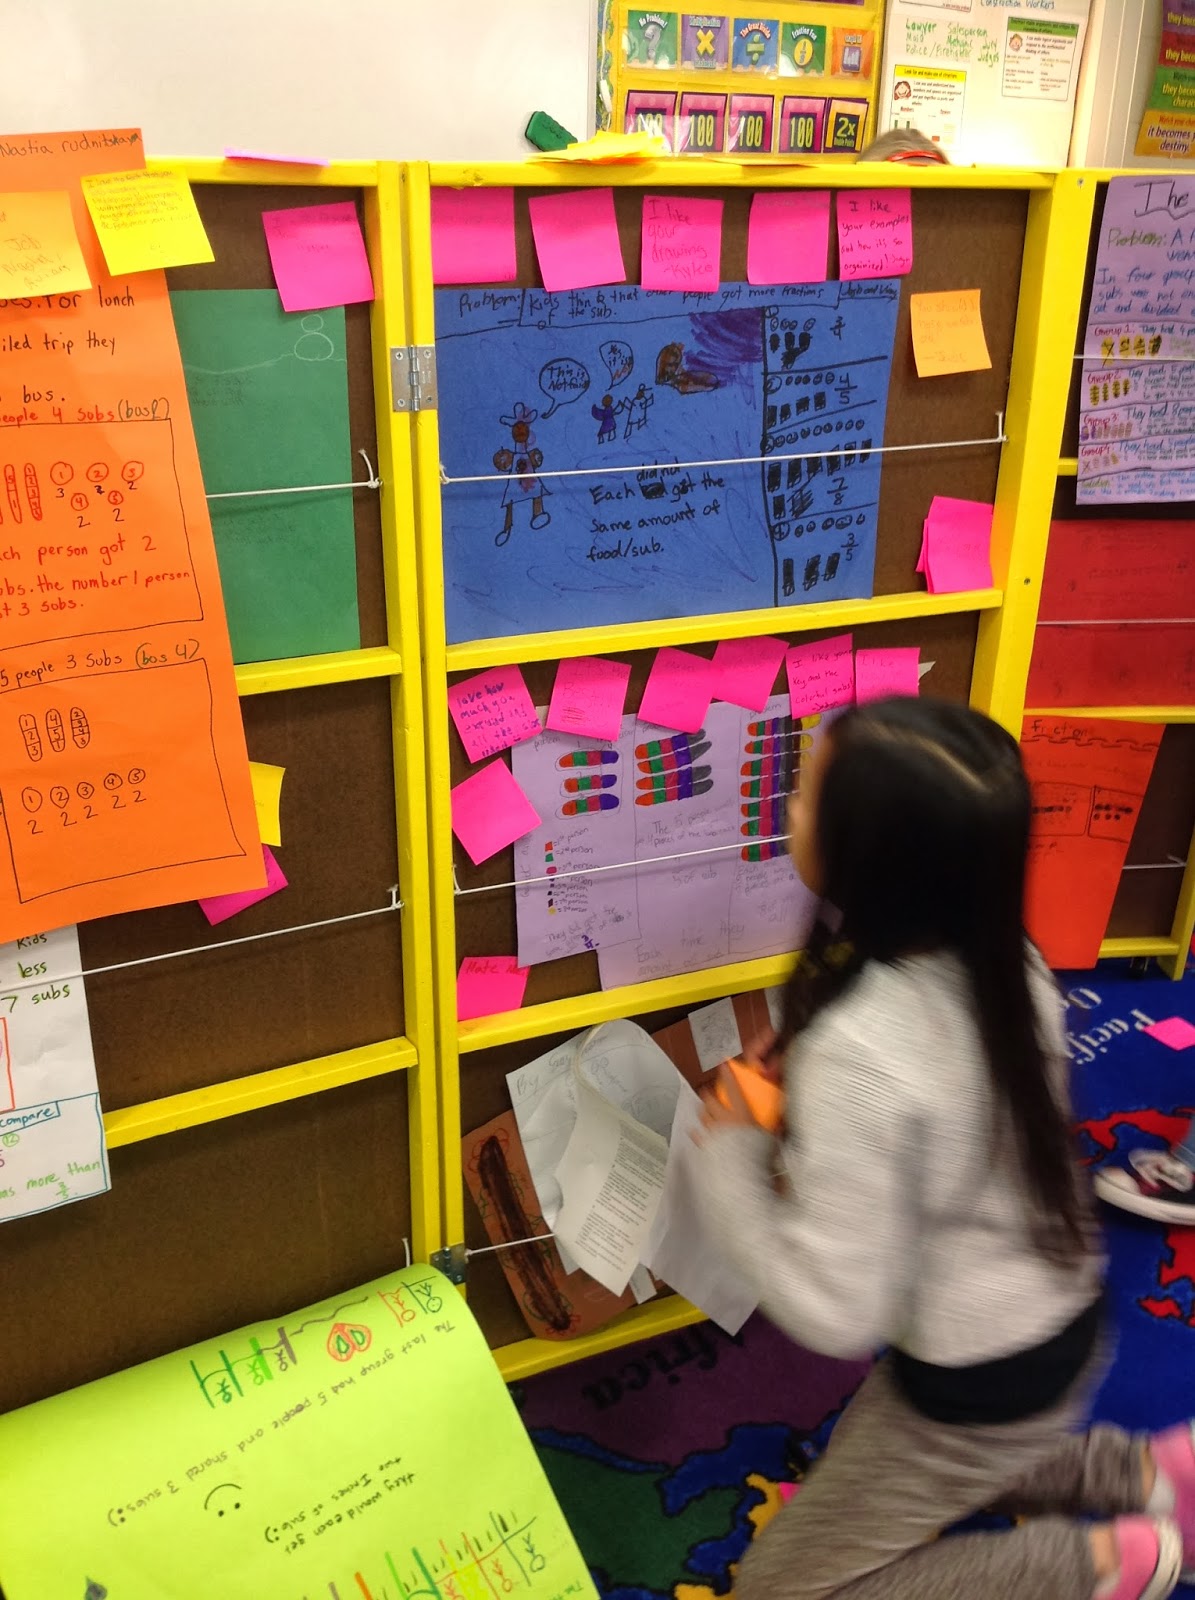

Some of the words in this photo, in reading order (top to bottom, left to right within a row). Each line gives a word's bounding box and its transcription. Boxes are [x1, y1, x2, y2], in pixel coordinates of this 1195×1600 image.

[905, 18, 937, 36] Lawyer
[690, 114, 714, 147] 100
[738, 115, 763, 147] 100
[790, 117, 814, 148] 100
[836, 117, 856, 138] 2x
[1147, 125, 1155, 137] it
[1156, 126, 1190, 139] becomes
[1133, 178, 1189, 212] The
[848, 200, 858, 212] I
[870, 199, 891, 213] like
[842, 222, 863, 237] your
[98, 285, 136, 309] lunch
[610, 288, 639, 303] that
[748, 287, 776, 298] more
[568, 307, 585, 319] the
[43, 331, 75, 355] trip
[86, 330, 116, 356] they
[547, 364, 573, 379] This
[839, 372, 851, 387] 4
[22, 385, 66, 405] bus.
[839, 391, 851, 405] 5
[52, 406, 63, 424] 4
[589, 482, 636, 505] Each
[701, 471, 725, 491] the
[832, 476, 845, 489] 7
[834, 493, 845, 506] 8
[590, 518, 632, 534] Same
[637, 502, 696, 528] amount
[702, 498, 721, 516] of
[37, 545, 89, 566] person
[99, 533, 126, 566] got
[141, 535, 156, 551] 2
[37, 573, 65, 593] the
[72, 571, 130, 592] number
[144, 570, 190, 588] person
[18, 602, 31, 617] 3
[15, 660, 55, 689] people
[66, 654, 78, 670] 3
[27, 819, 43, 835] 2
[60, 811, 77, 828] 2
[84, 805, 98, 820] 2
[112, 795, 126, 809] 2
[133, 790, 146, 803] 2
[16, 932, 48, 950] Kids
[18, 961, 48, 979] less
[31, 984, 71, 1005] subs
[0, 1107, 55, 1128] compare
[26, 1173, 60, 1190] more
[67, 1161, 100, 1176] than
[401, 1334, 427, 1354] last
[360, 1347, 395, 1377] group
[331, 1376, 356, 1395] had
[317, 1391, 328, 1406] 5
[272, 1397, 312, 1429] people
[236, 1428, 264, 1452] and
[185, 1451, 228, 1481] shared
[166, 1480, 179, 1494] 3
[383, 1472, 414, 1491] they
[346, 1491, 382, 1520] would
[313, 1513, 343, 1536] each
[284, 1532, 306, 1554] get
